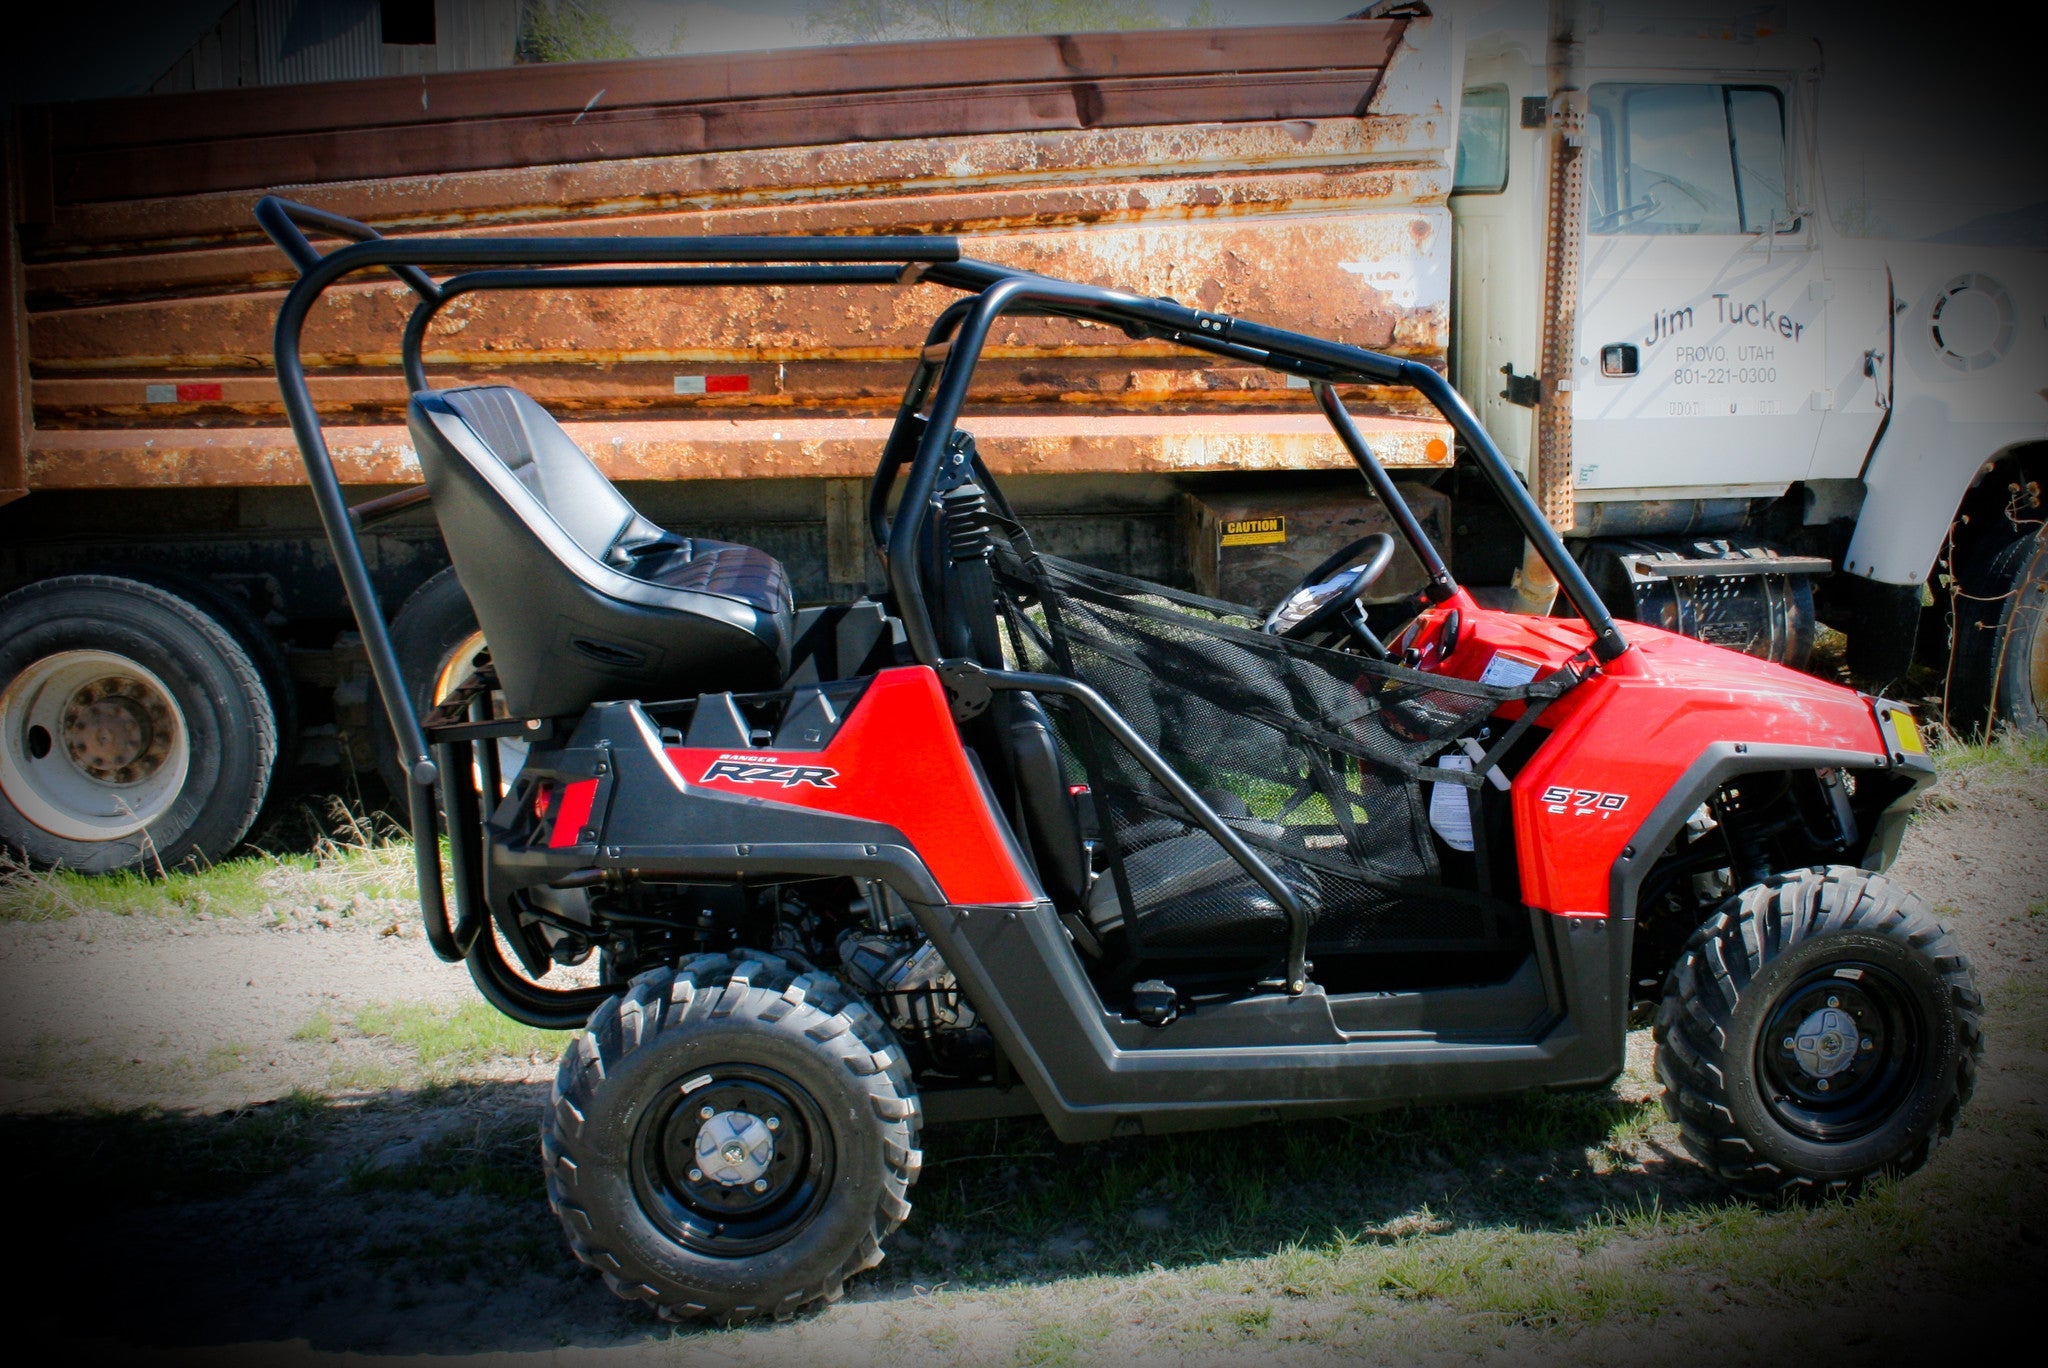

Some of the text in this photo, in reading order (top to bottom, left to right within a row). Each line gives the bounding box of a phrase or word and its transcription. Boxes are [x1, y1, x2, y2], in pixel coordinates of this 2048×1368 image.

[1644, 293, 1805, 347] Jim Tucker
[1676, 346, 1774, 362] PROVO, UTAH
[1674, 368, 1776, 384] 801-221-0300
[1227, 520, 1278, 533] CAUTION
[719, 754, 778, 763] RANGER
[699, 760, 840, 788] RZR
[1541, 786, 1628, 811] 570
[1547, 804, 1610, 820] EFI
